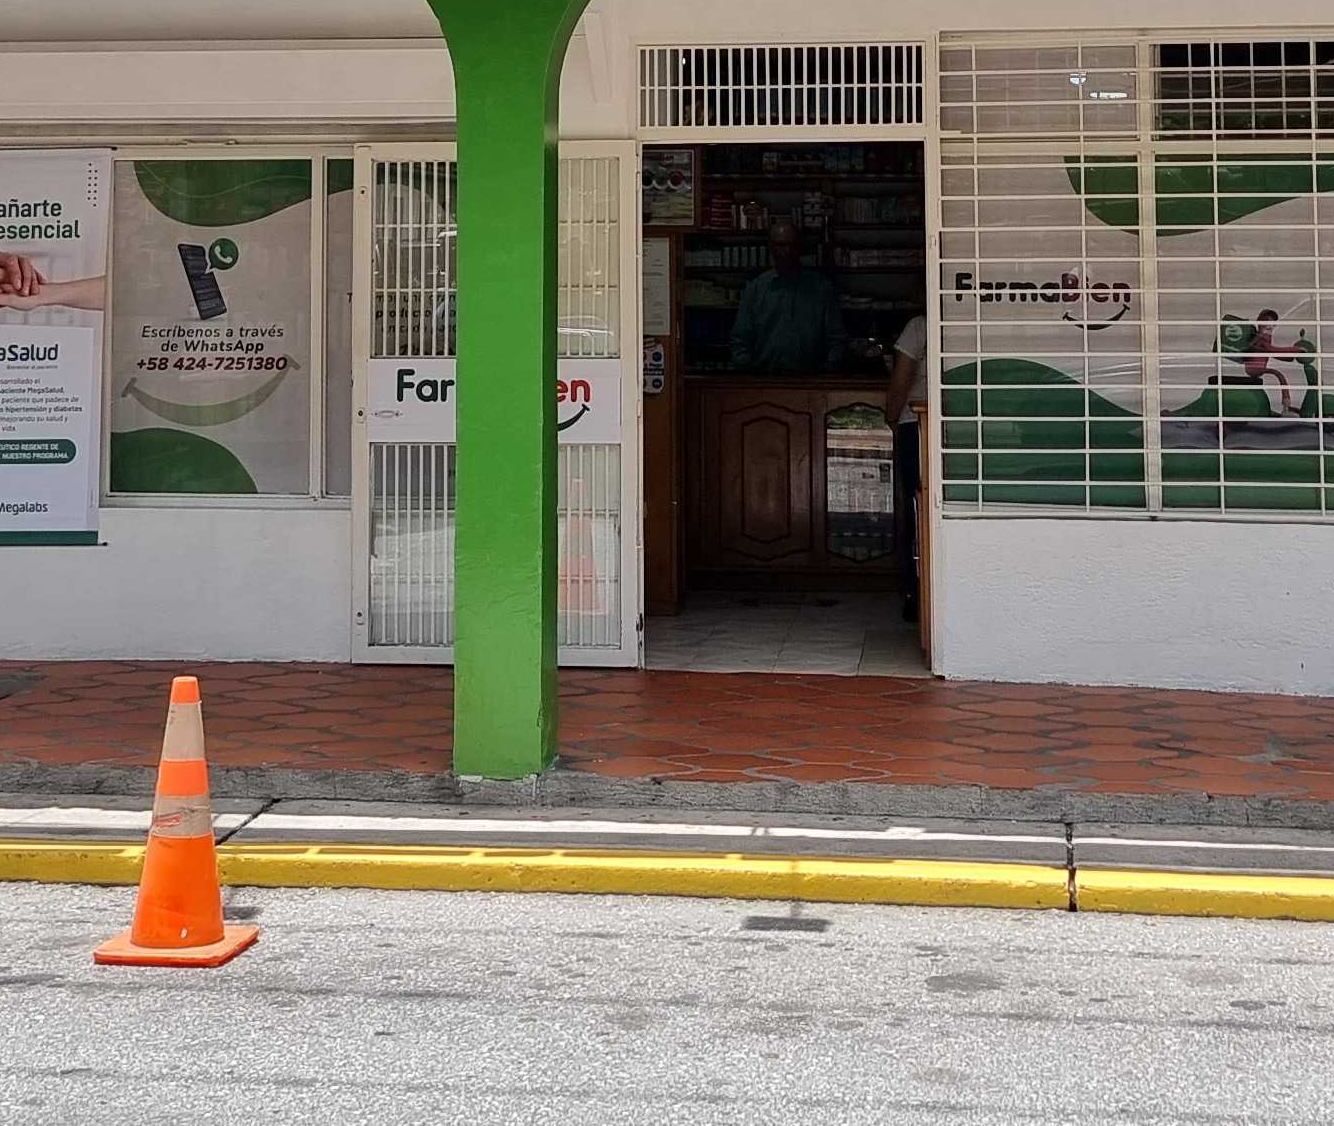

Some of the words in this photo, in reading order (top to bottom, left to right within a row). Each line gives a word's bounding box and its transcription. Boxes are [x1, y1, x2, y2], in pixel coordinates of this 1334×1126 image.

[142, 324, 220, 338] Escríbenos
[225, 328, 234, 338] a
[239, 324, 284, 338] través
[161, 340, 179, 352] de
[184, 339, 265, 354] WhatsApp
[136, 356, 169, 371] +58
[173, 356, 288, 371] 424-7251380
